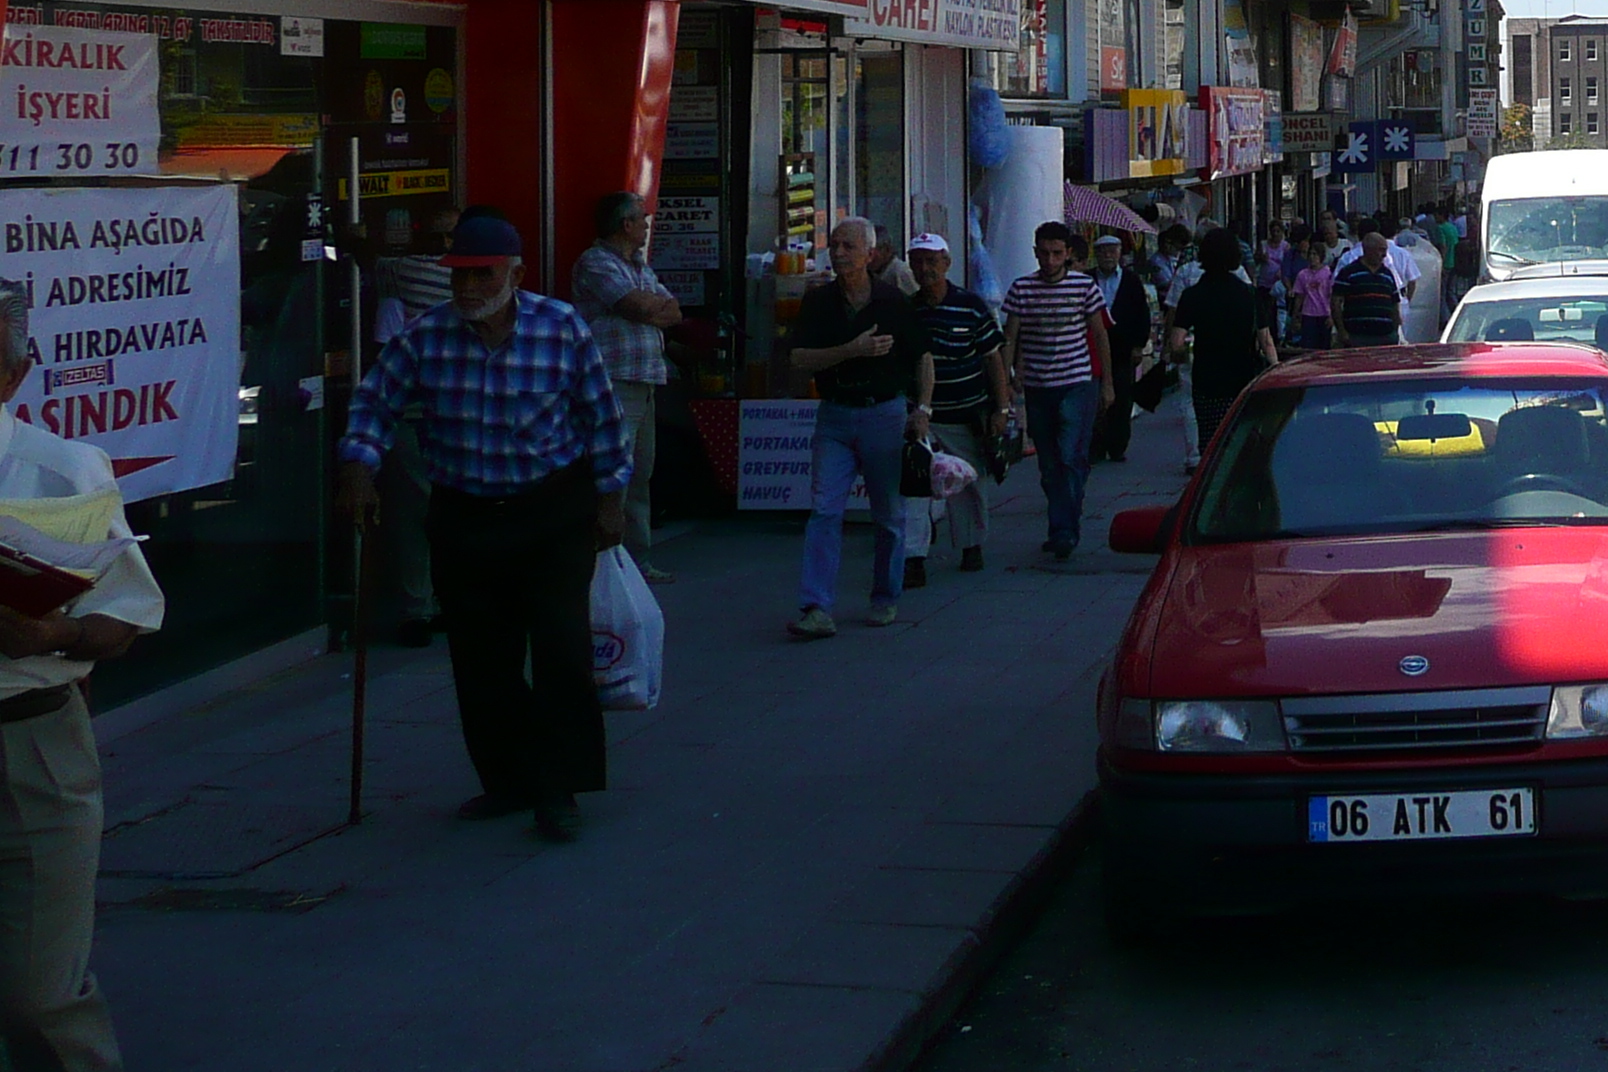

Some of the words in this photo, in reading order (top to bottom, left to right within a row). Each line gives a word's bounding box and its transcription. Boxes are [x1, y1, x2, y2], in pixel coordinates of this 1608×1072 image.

[2, 32, 126, 70] KİRALIK
[18, 85, 111, 126] İŞYERİ
[56, 143, 92, 169] 30
[105, 142, 139, 168] 30
[345, 175, 390, 196] WALT
[659, 197, 706, 209] KSEL
[6, 215, 81, 253] BİNA
[90, 212, 205, 255] AŞAĞIDA
[46, 262, 191, 308] ADRESİMİZ
[55, 318, 207, 362] HIRDAVATA
[743, 408, 788, 420] PORTAKAL
[743, 461, 812, 475] GREYFUR
[743, 485, 792, 503] HAVUÇ
[1329, 799, 1369, 837] 06
[1393, 795, 1452, 836] ATK
[1489, 791, 1524, 832] 61
